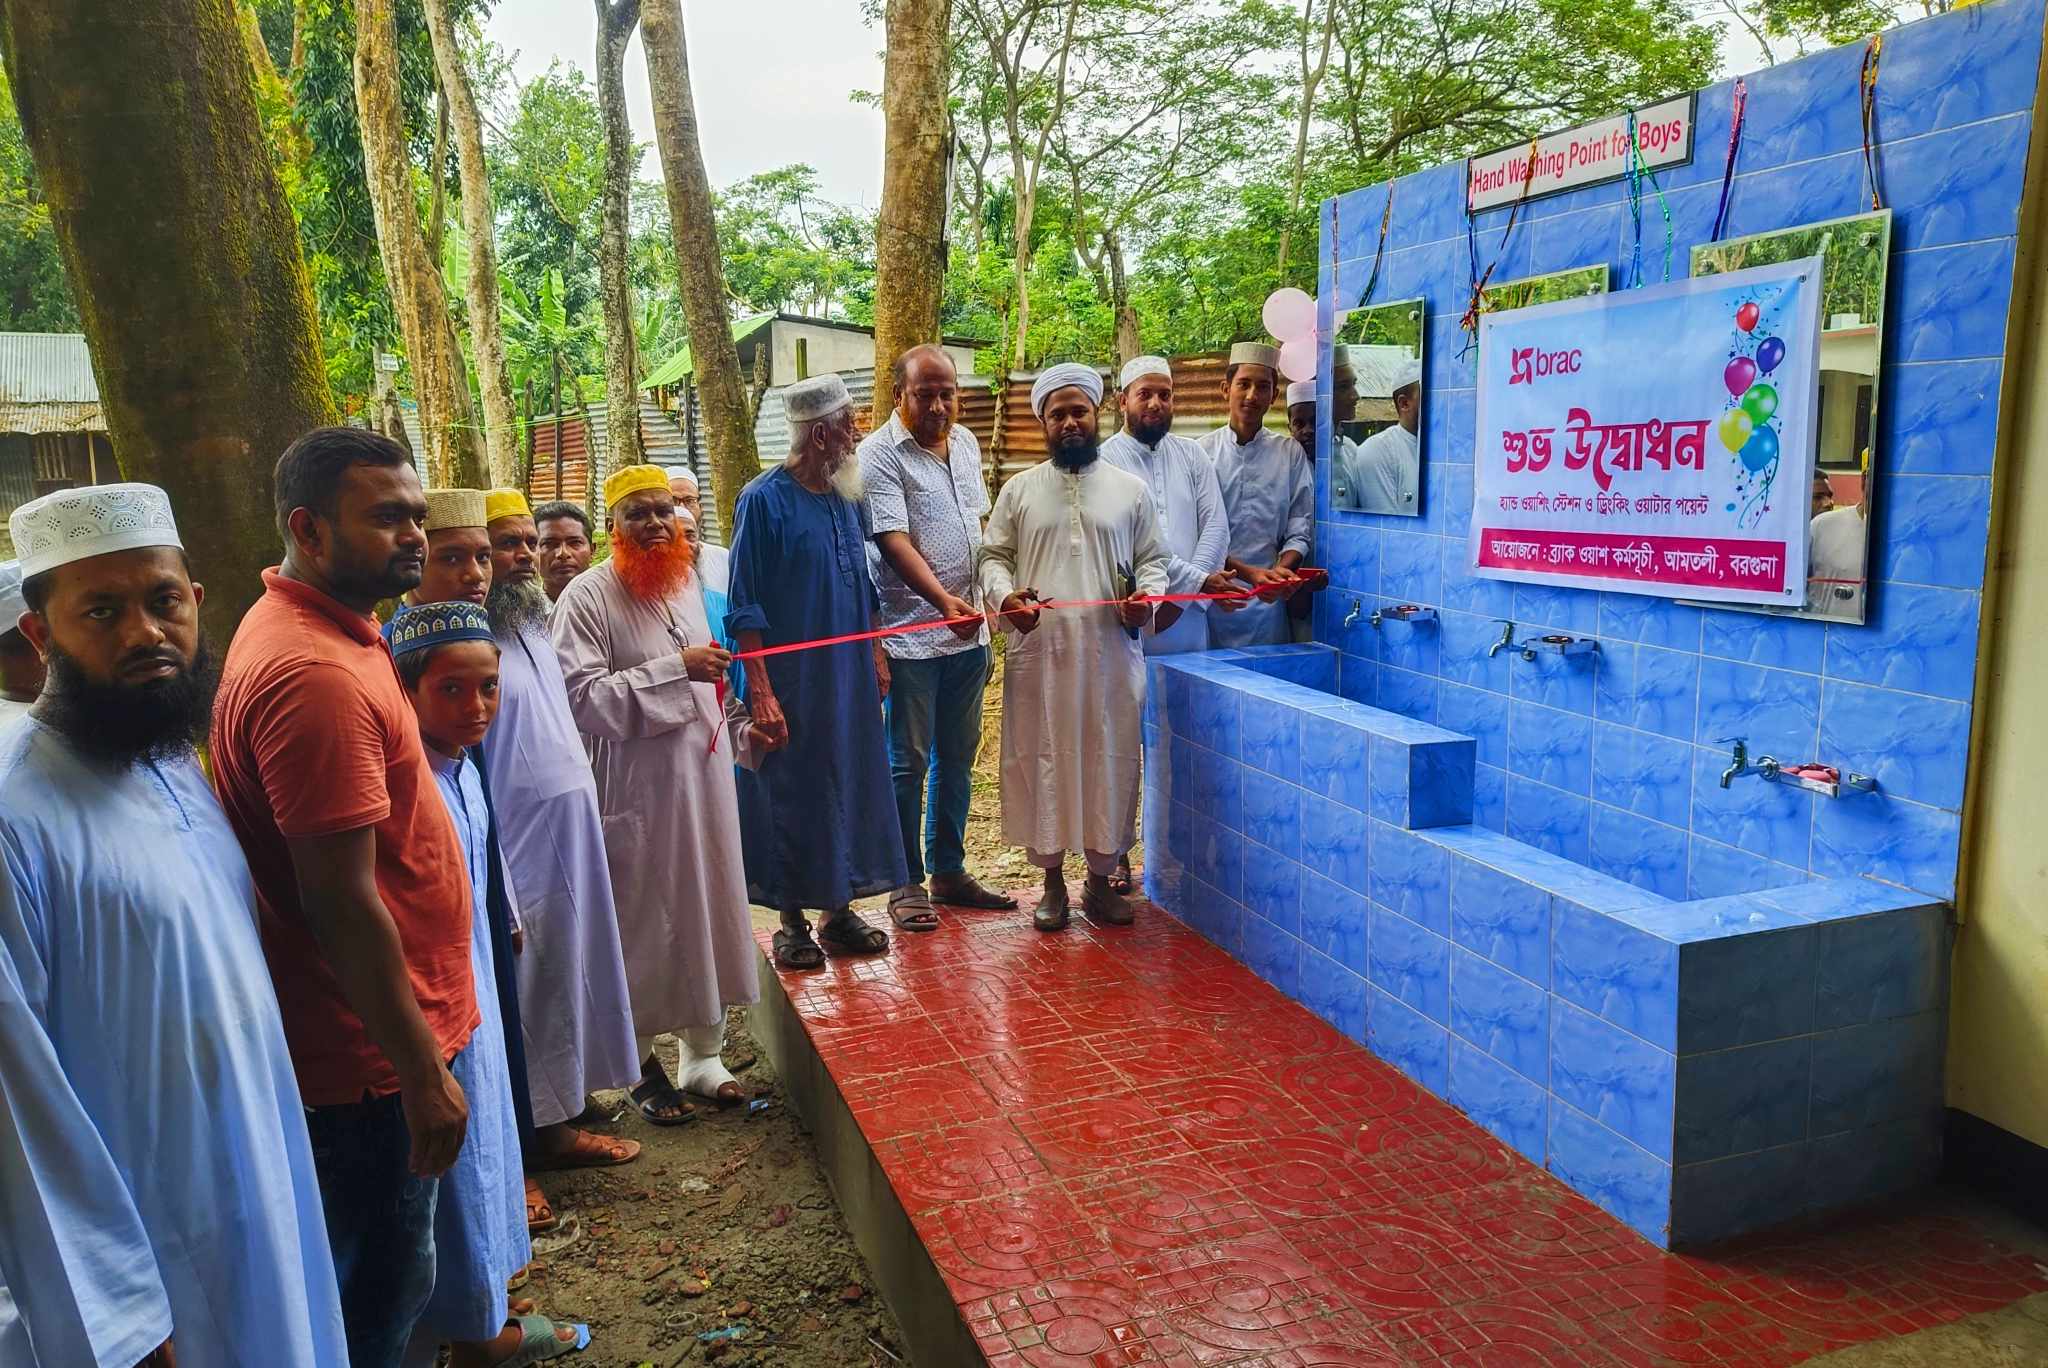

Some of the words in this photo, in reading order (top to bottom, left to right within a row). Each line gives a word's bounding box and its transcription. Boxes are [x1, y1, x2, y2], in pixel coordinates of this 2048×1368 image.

[1474, 161, 1504, 194] Hand
[1508, 150, 1565, 184] Wahing
[1568, 136, 1608, 168] Point
[1638, 119, 1682, 152] Boys
[1536, 347, 1582, 377] brac
[1502, 428, 1556, 473] শুভ
[1563, 407, 1713, 492] উদ্বোধন
[1520, 491, 1551, 513] ওয়াশিং
[1552, 492, 1582, 513] স্টেশন
[1585, 497, 1593, 512] ও
[1597, 491, 1631, 516] ড্রিংকিং
[1635, 492, 1672, 515] ওয়াটার
[1675, 494, 1710, 516] পয়েন্ট
[1490, 539, 1541, 561] আয়োজনে
[1578, 545, 1610, 567] ওয়াশ
[1728, 554, 1779, 579] বরগুনা
